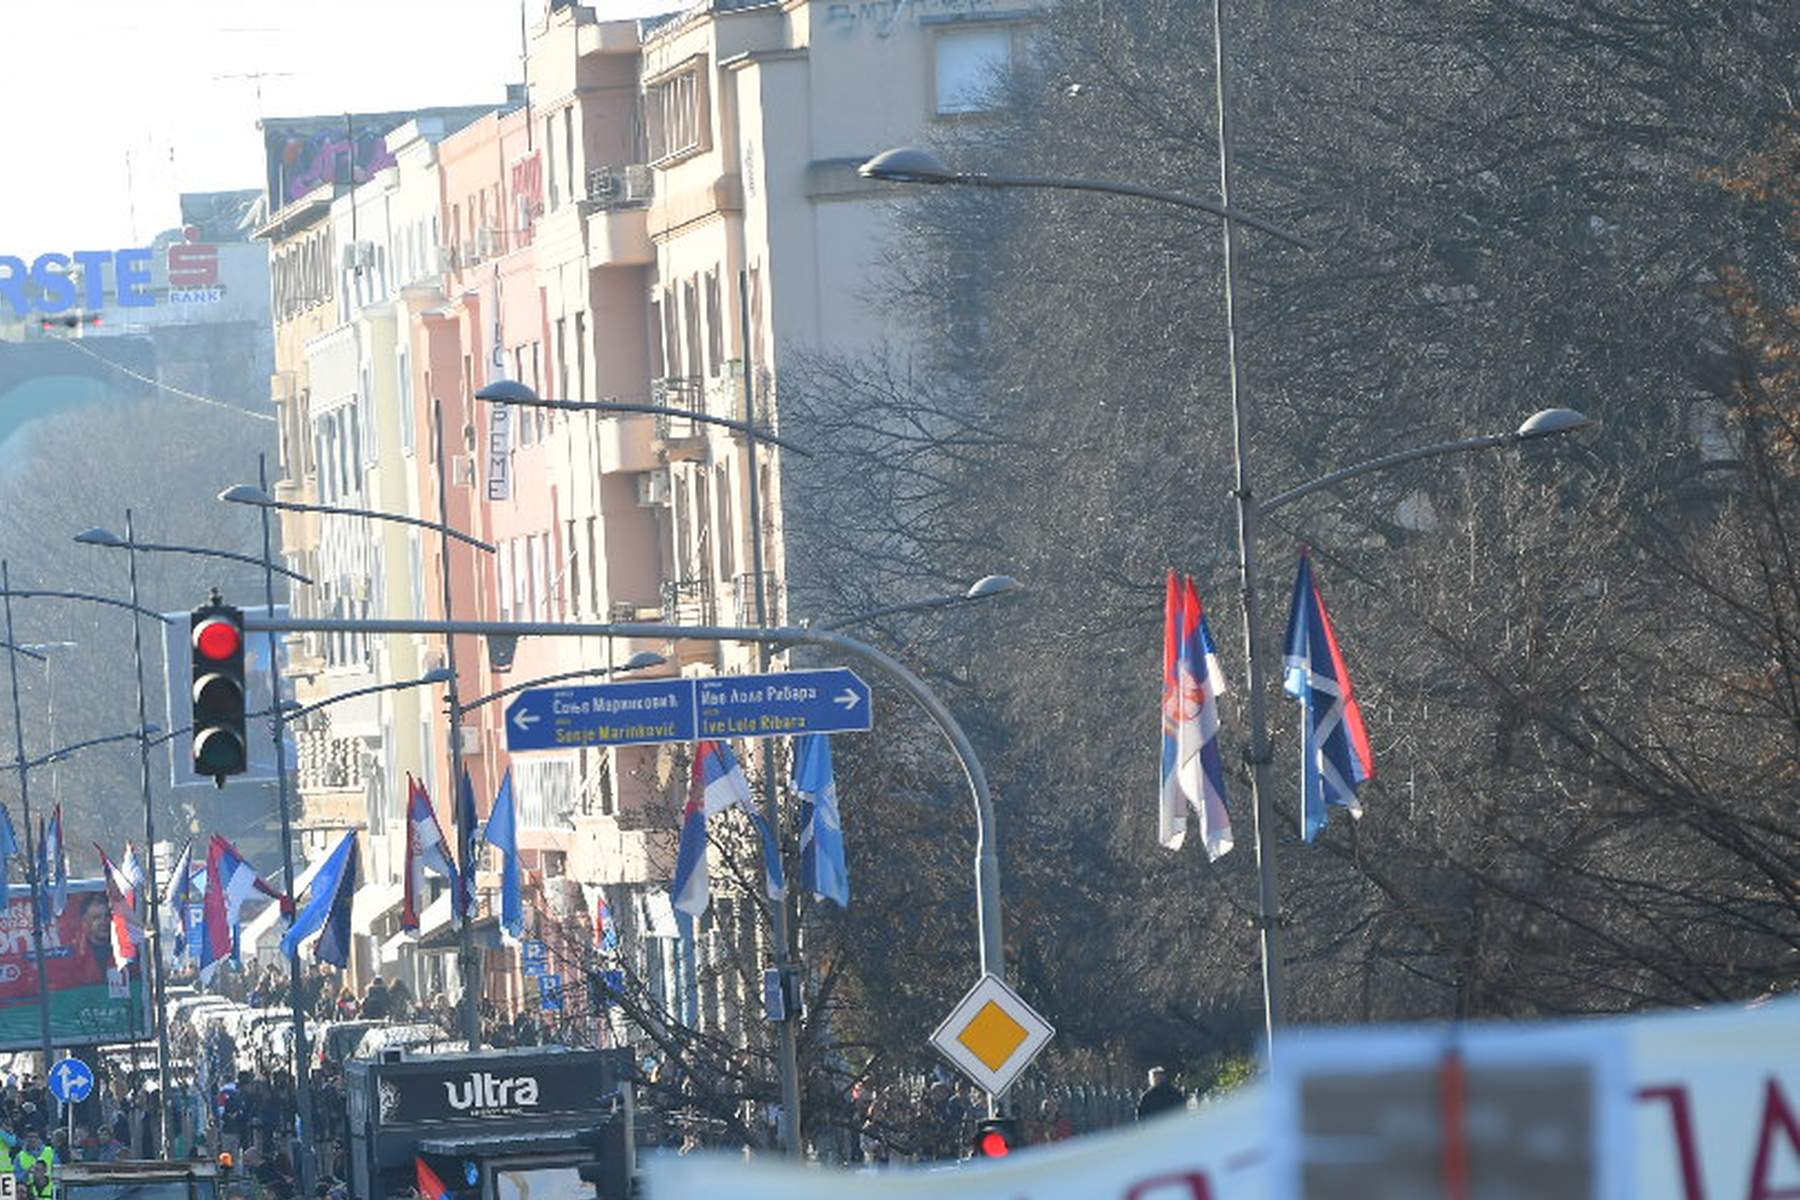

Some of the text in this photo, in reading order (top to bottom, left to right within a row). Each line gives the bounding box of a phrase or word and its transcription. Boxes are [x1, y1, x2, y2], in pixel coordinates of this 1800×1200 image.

[598, 721, 676, 741] Marinković
[760, 714, 807, 730] Ribara
[443, 1072, 539, 1110] ultra
